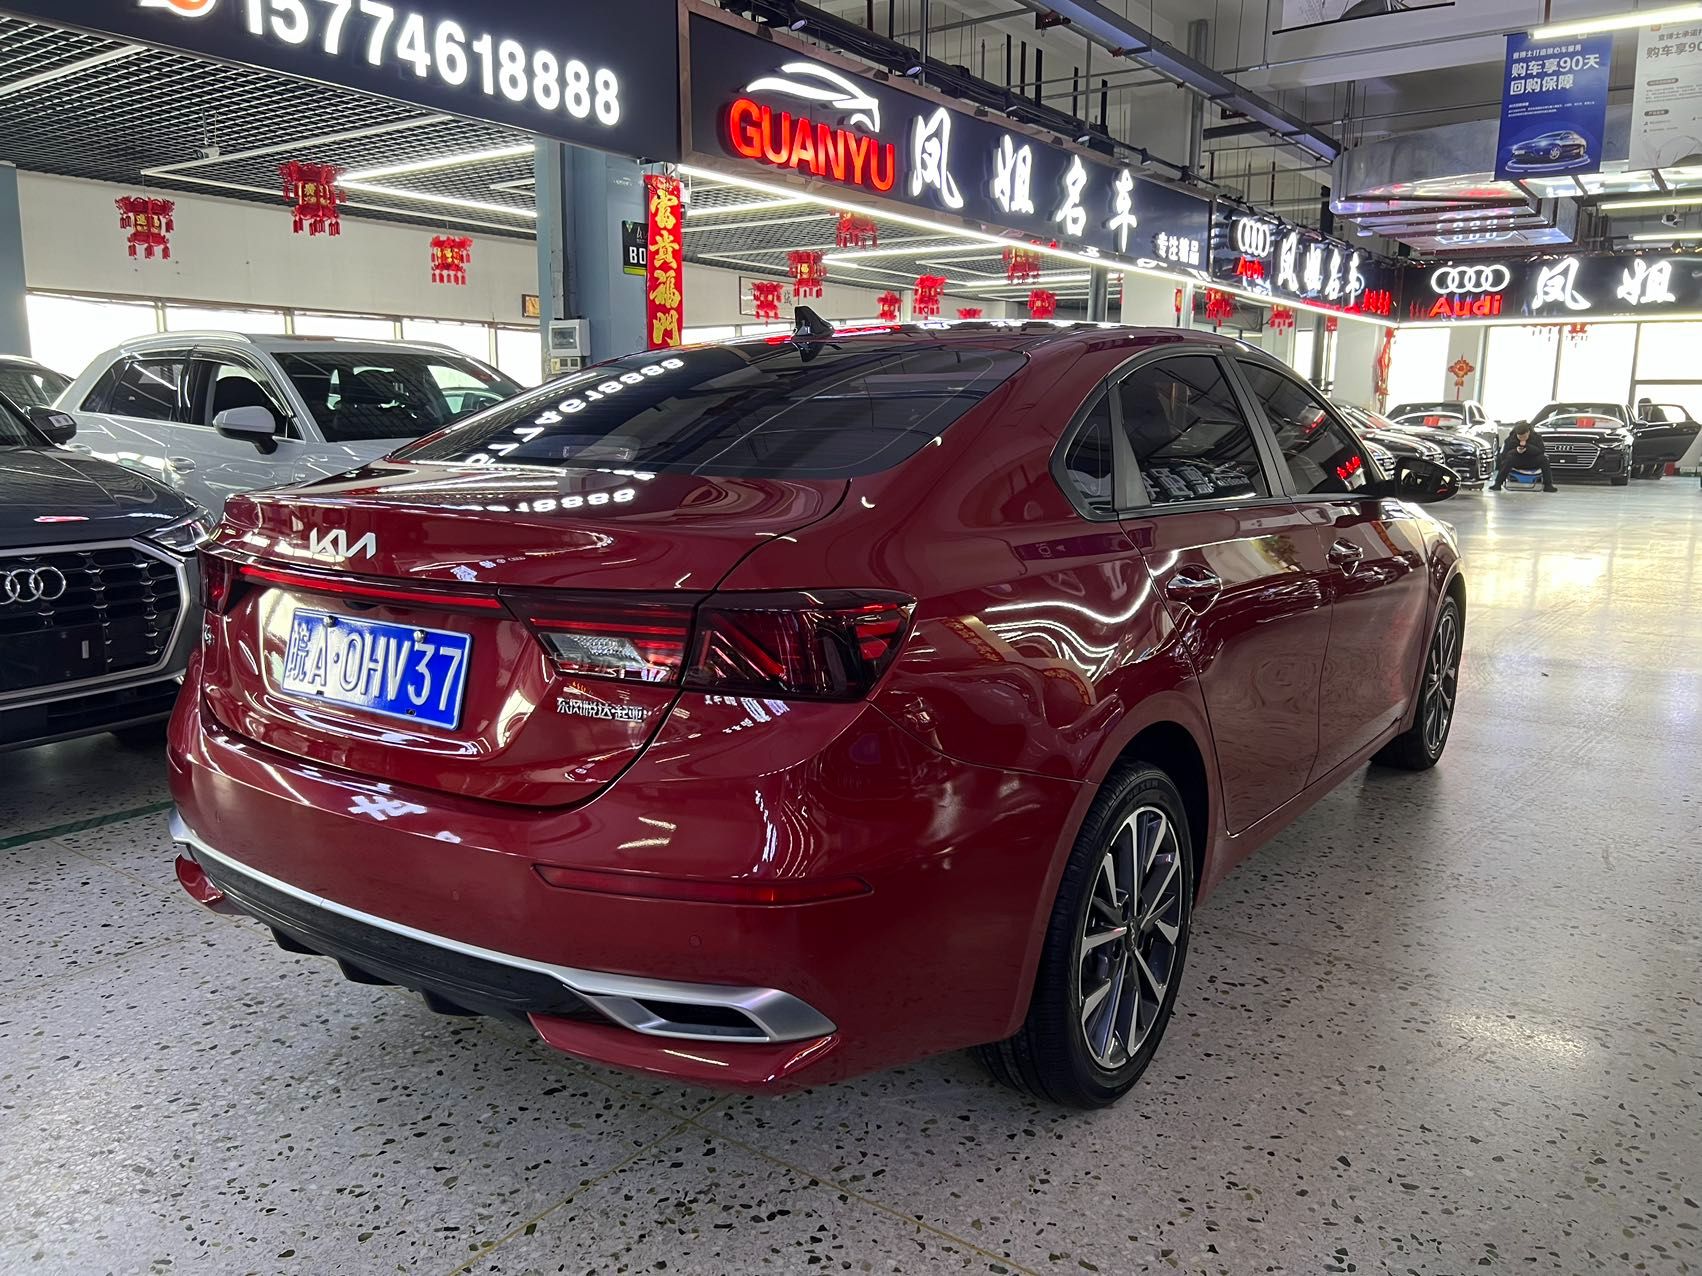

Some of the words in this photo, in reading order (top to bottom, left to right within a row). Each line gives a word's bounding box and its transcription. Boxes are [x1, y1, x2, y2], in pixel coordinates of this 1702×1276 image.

[245, 0, 623, 127] 15774618888
[1511, 54, 1600, 78] 购车享90天
[1509, 74, 1575, 96] 回购保障
[728, 98, 895, 192] GUANYU
[911, 106, 1138, 253] 凤姐名车
[1237, 255, 1265, 280] Audi
[1531, 257, 1677, 311] 凤姐
[1429, 294, 1503, 318] Audi
[309, 528, 377, 560] KIA
